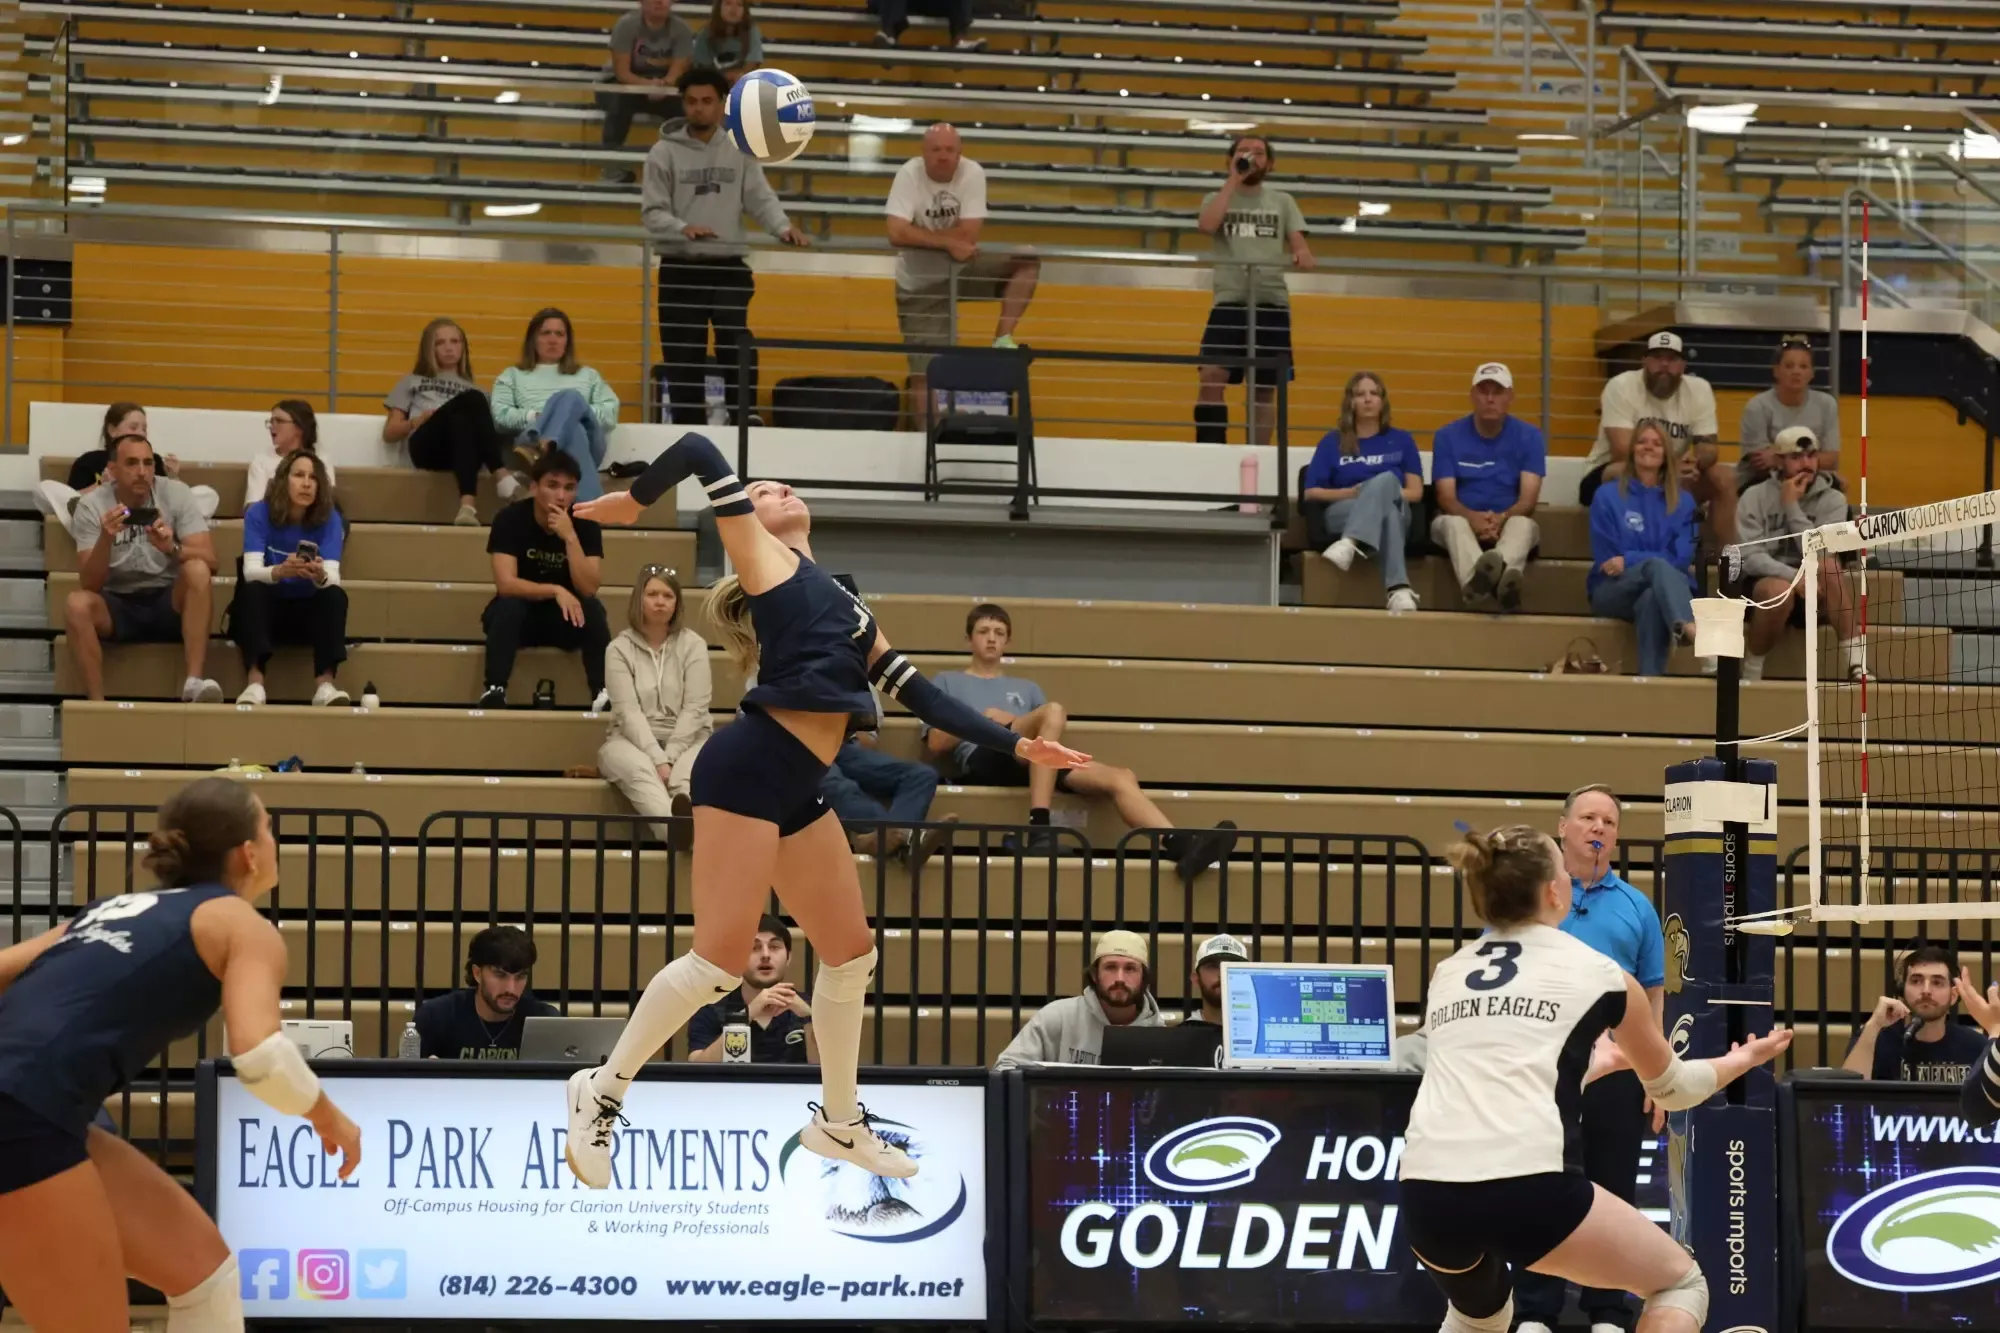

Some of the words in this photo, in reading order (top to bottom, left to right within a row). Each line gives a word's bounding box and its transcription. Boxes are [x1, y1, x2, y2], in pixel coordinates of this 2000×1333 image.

[1858, 511, 1907, 541] CLARION
[1907, 501, 1952, 529] GOLDEN
[1955, 492, 1996, 522] EAGLES
[1665, 796, 1692, 813] CLARION
[1724, 833, 1736, 882] sports
[1465, 941, 1523, 991] 3
[1431, 998, 1481, 1030] GOLDEN
[1486, 996, 1561, 1022] EAGLES
[238, 1118, 360, 1189] EAGL
[387, 1119, 494, 1189] PARK
[1306, 1136, 1404, 1181] HO
[1726, 1139, 1747, 1207] sports
[384, 1199, 472, 1216] Off-Campus
[478, 1200, 538, 1216] Housing
[542, 1200, 565, 1216] for
[570, 1200, 623, 1214] Clarion
[629, 1200, 702, 1218] University
[706, 1201, 770, 1215] Students
[588, 1220, 598, 1233] &
[605, 1220, 668, 1237] Working
[673, 1221, 770, 1236] Professionals
[1060, 1202, 1399, 1270] GOLDEN
[440, 1275, 497, 1297] (814)
[505, 1276, 638, 1296] 226-4300
[666, 1274, 964, 1302] www.eagle-park.net
